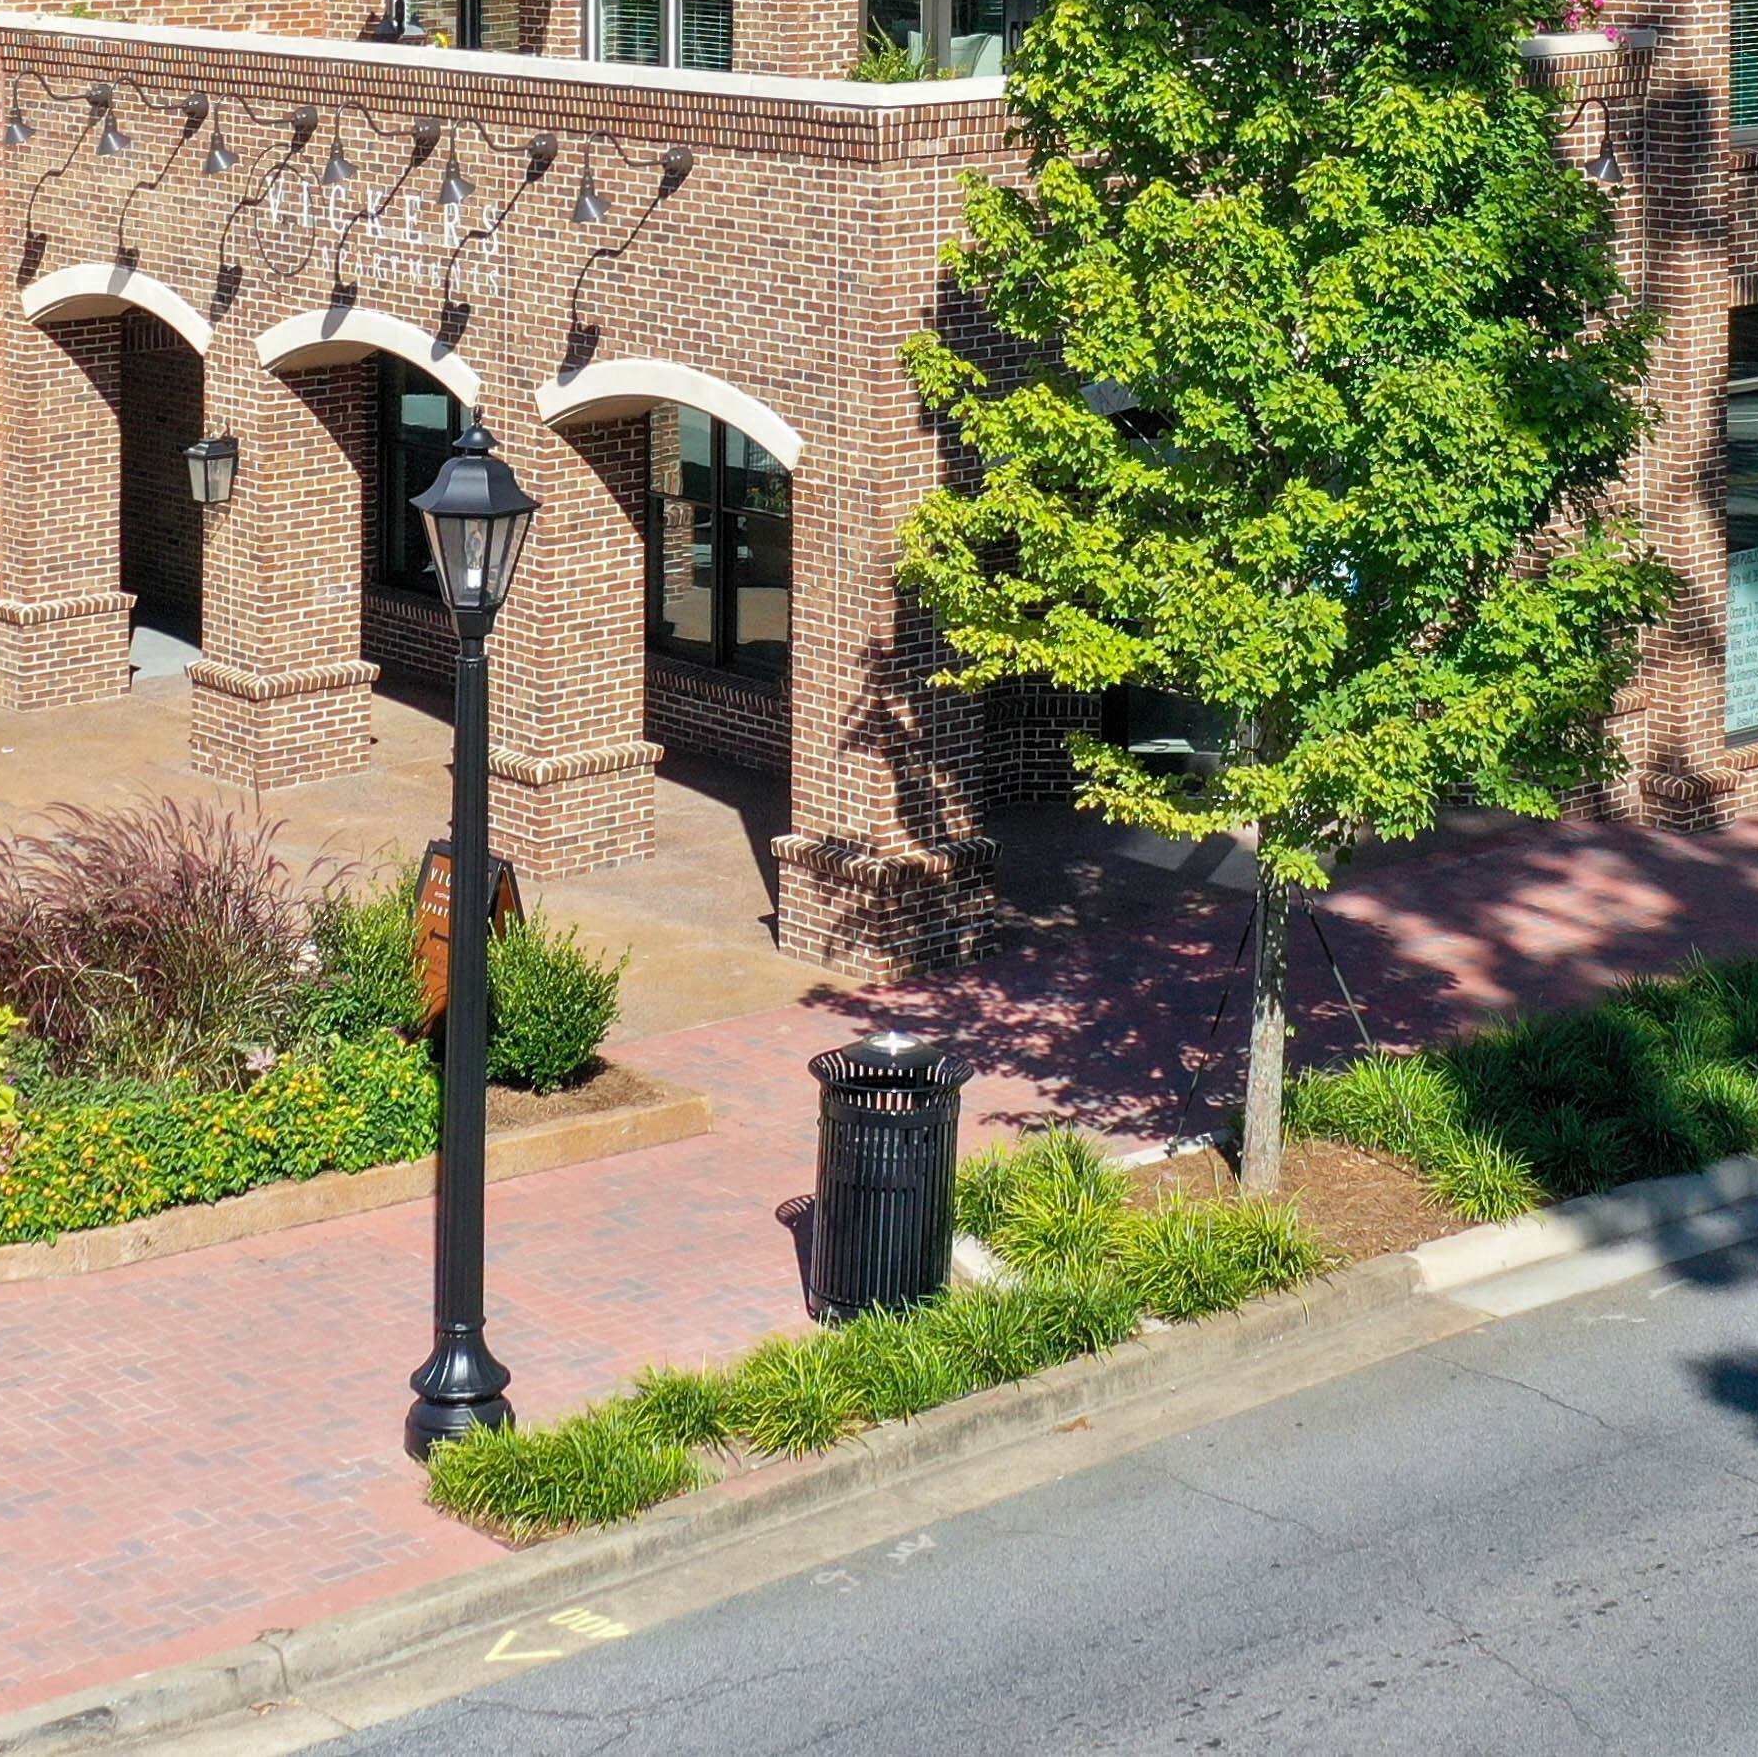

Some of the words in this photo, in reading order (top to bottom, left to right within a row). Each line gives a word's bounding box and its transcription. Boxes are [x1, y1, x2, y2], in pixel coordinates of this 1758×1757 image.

[266, 176, 499, 255] VICKERS
[322, 245, 501, 298] APARTMENTS
[421, 900, 450, 920] APART
